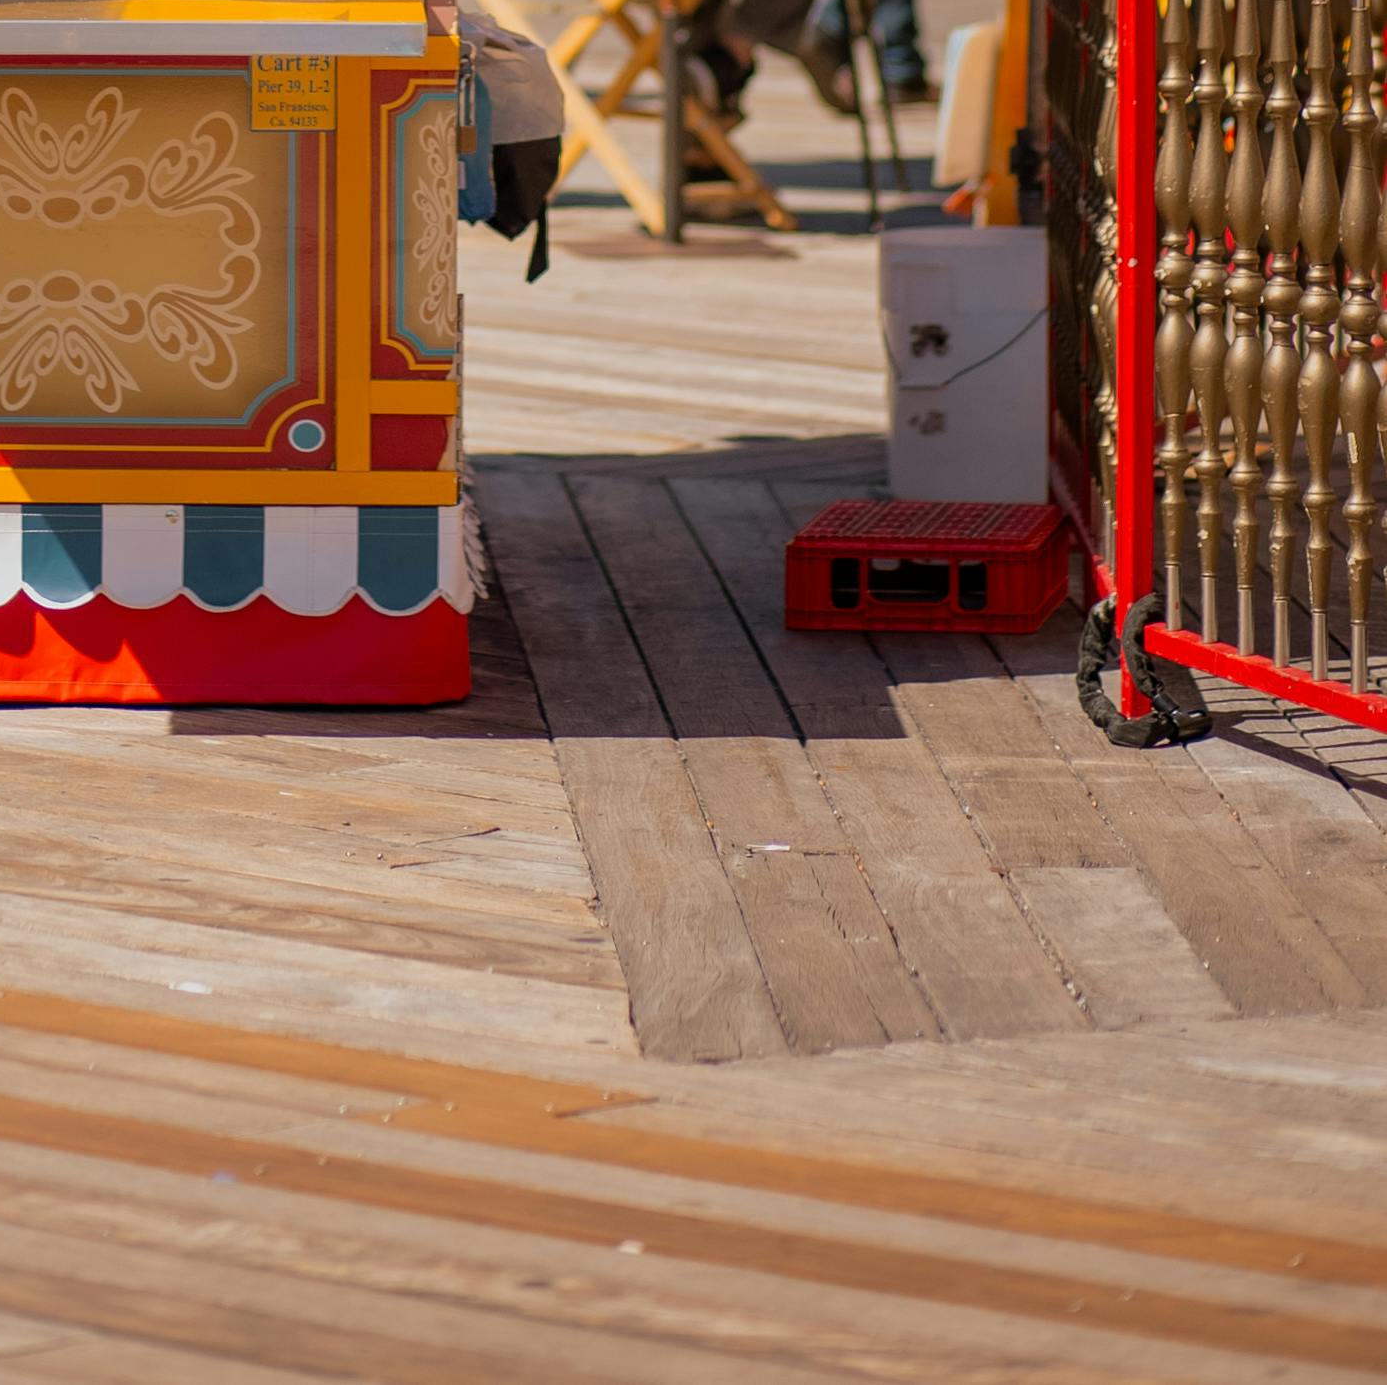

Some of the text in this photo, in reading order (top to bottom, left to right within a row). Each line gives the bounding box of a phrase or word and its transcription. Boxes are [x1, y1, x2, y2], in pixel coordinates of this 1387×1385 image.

[257, 55, 302, 72] Cart
[258, 79, 283, 94] Pier
[287, 79, 305, 95] 39,
[258, 102, 277, 112] San
